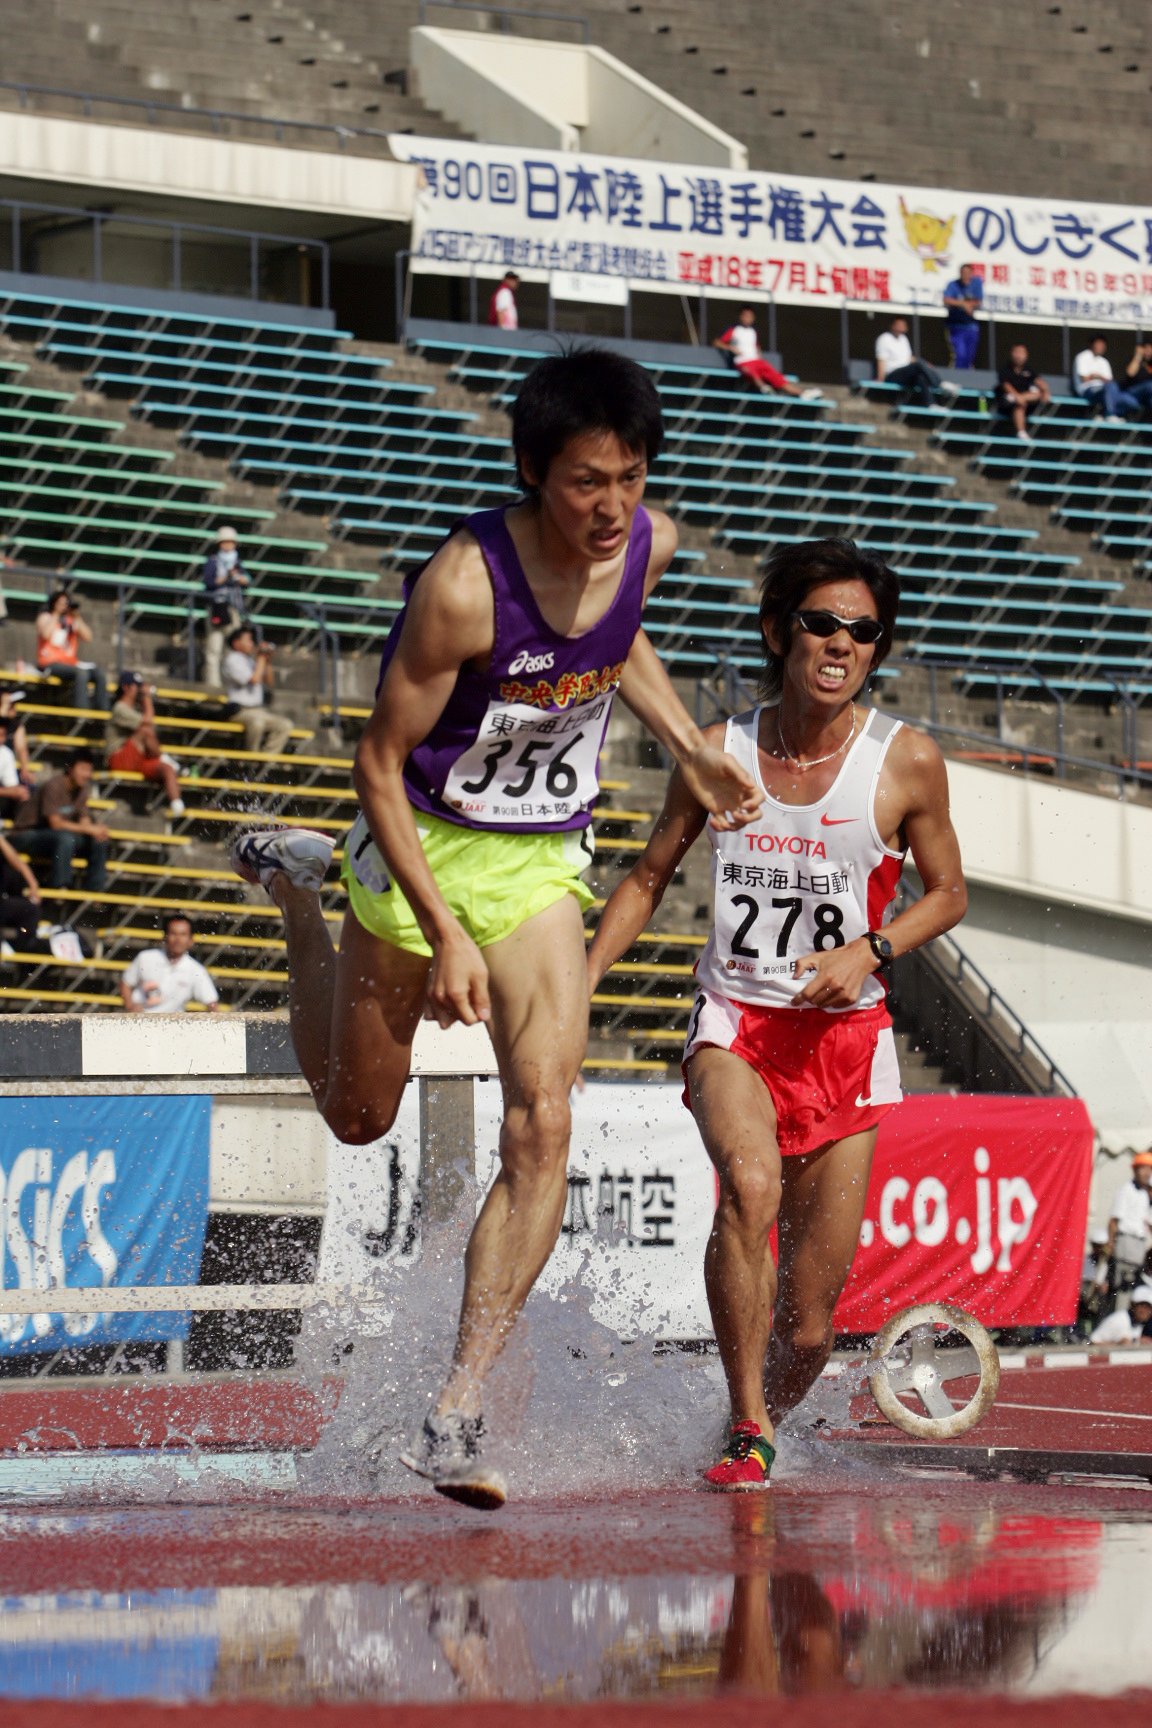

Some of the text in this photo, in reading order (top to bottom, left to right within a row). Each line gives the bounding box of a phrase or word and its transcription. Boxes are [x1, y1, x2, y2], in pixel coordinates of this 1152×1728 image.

[461, 732, 585, 798] 356
[722, 862, 849, 895] 東京海上日動
[745, 833, 827, 859] TOYOTA
[730, 893, 846, 958] 278
[860, 1146, 1039, 1275] .co.jp
